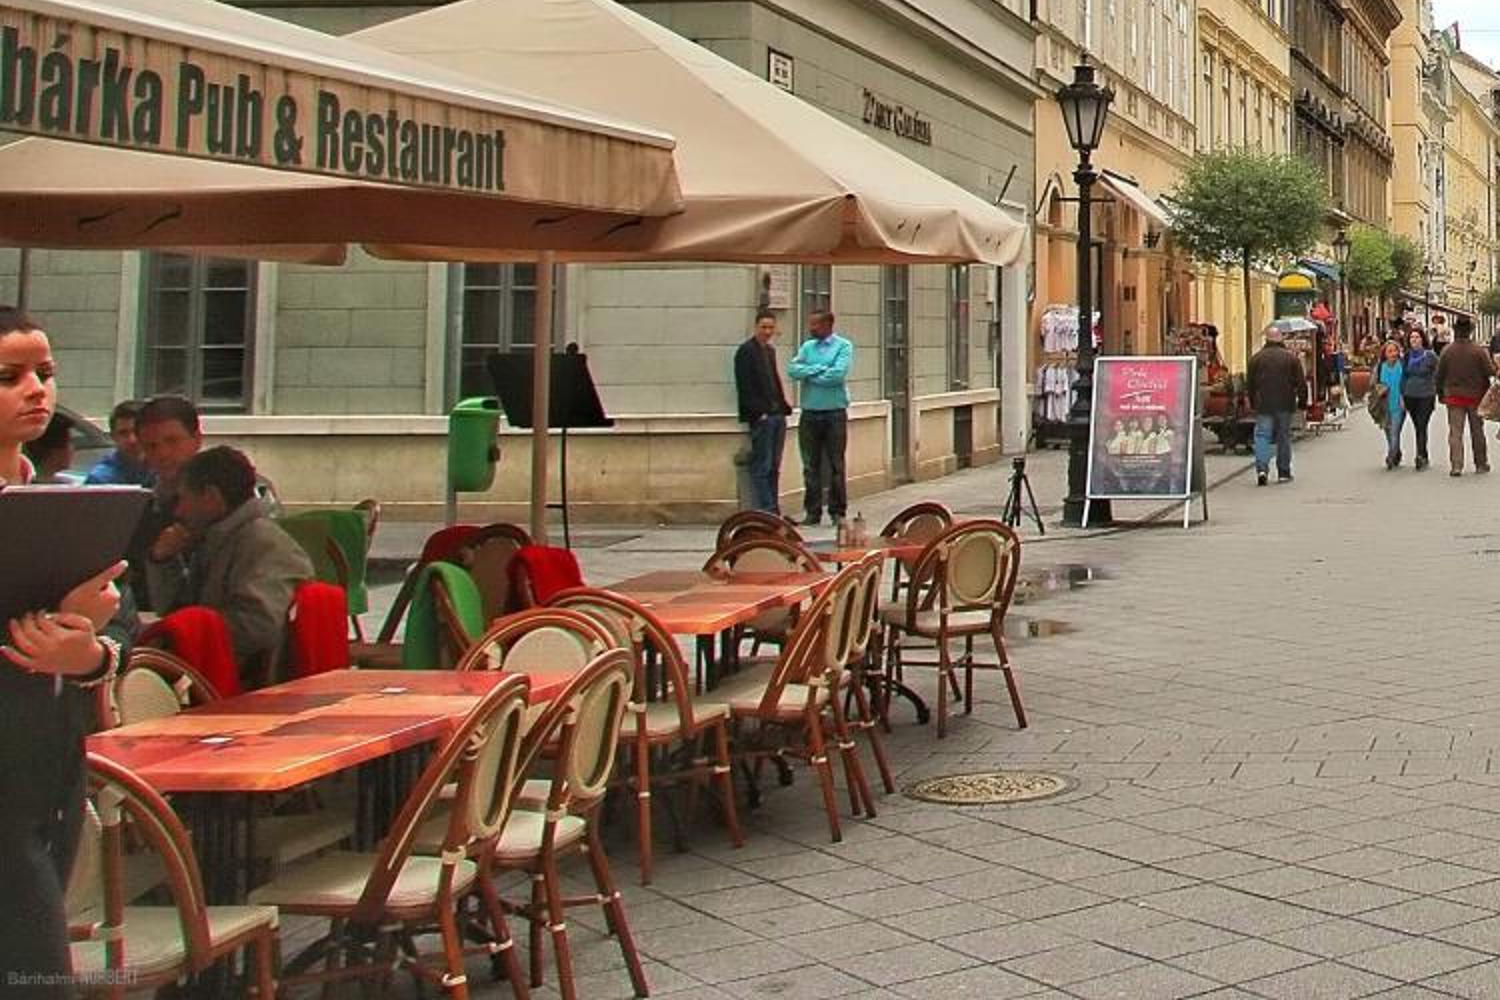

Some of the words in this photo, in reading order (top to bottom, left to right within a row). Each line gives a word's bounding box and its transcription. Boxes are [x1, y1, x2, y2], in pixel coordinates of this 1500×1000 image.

[0, 25, 162, 146] bárka
[176, 62, 264, 159] Pub
[273, 94, 304, 166] &
[316, 89, 507, 192] Restaurant
